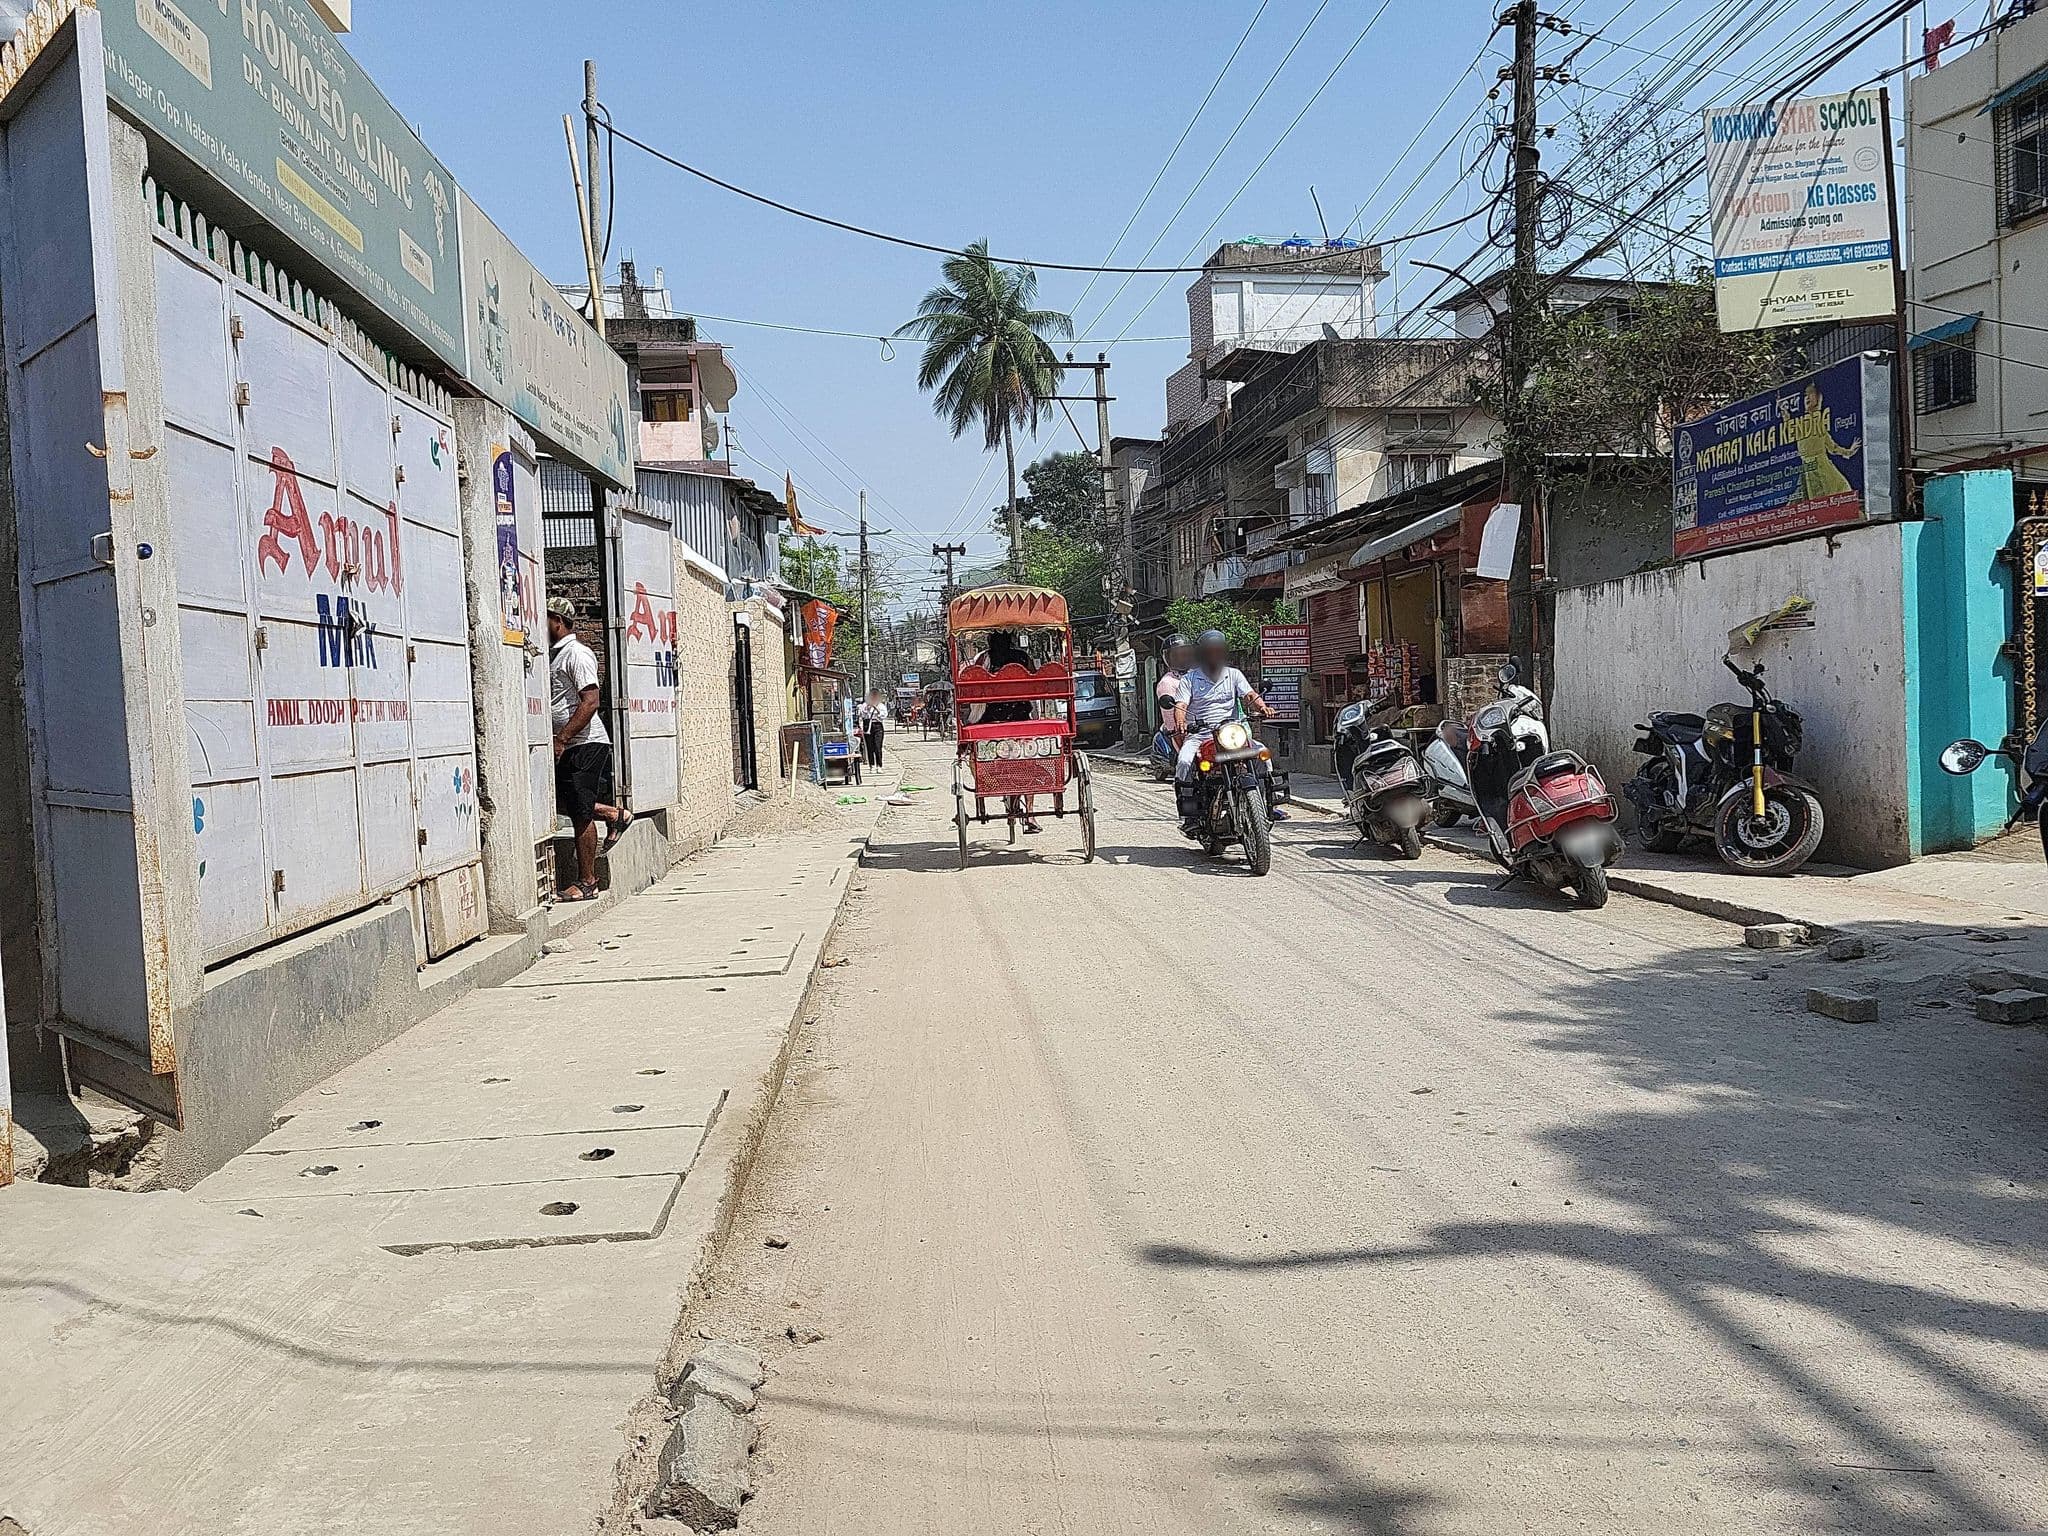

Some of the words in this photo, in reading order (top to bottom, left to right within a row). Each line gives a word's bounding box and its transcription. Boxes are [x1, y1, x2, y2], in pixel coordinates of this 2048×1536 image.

[153, 0, 191, 40] MORNING
[153, 18, 170, 41] AM
[171, 34, 185, 57] TO
[118, 55, 156, 108] Nagar,
[157, 90, 183, 127] Opp.
[184, 111, 219, 161] Nataraj
[220, 140, 241, 175] Kala
[240, 0, 347, 141] HOMOEO
[352, 112, 413, 210] CLINIC
[1712, 110, 1778, 143] MORNING
[1782, 106, 1817, 135] STAR
[1819, 98, 1877, 131] SCHOOL
[242, 53, 268, 102] DR.
[270, 82, 333, 163] BISWAJIT
[334, 147, 379, 209] BAIRAGI
[1795, 139, 1806, 155] for
[1809, 136, 1820, 150] the
[1752, 192, 1790, 214] Group
[1807, 184, 1824, 208] KG
[1826, 182, 1876, 206] Classes
[1760, 216, 1807, 231] Admissions
[1808, 213, 1831, 229] going
[1832, 212, 1843, 222] on
[1741, 238, 1751, 250] 25
[1751, 237, 1773, 250] Years
[1760, 294, 1806, 307] SHYAM
[1810, 289, 1855, 301] STEEL
[1696, 436, 1743, 473] NATARAJ
[1746, 425, 1776, 457] KALA
[1780, 407, 1830, 446] KENDRA
[258, 446, 404, 599] Amul
[1265, 629, 1286, 637] ONLINE
[1287, 628, 1307, 636] APPLY
[267, 699, 305, 727] AMUL
[308, 699, 345, 725] DOODH
